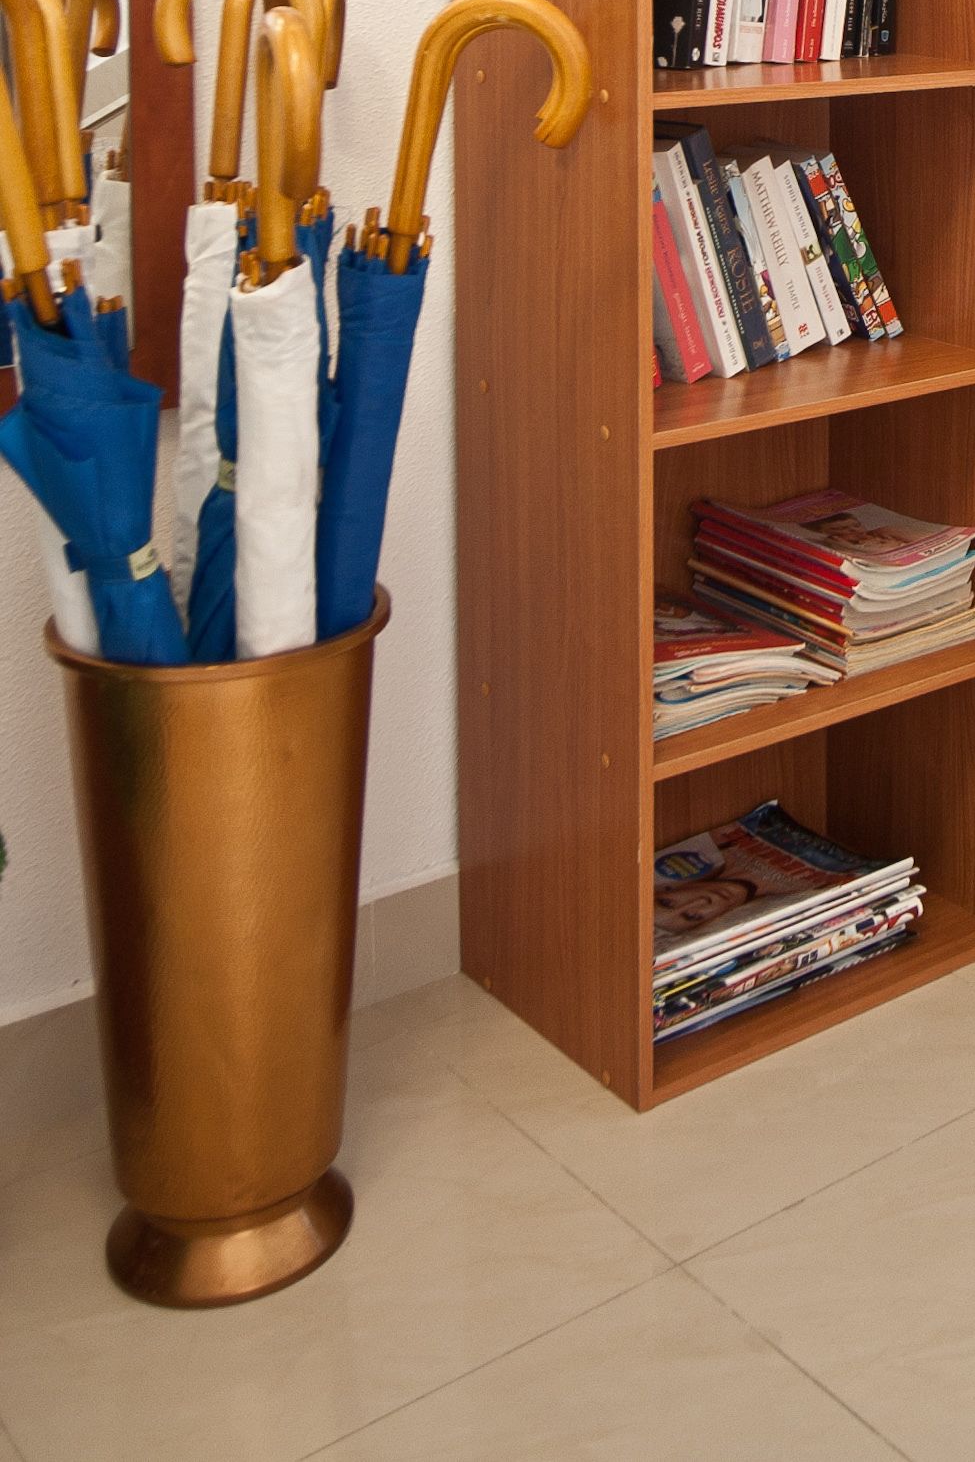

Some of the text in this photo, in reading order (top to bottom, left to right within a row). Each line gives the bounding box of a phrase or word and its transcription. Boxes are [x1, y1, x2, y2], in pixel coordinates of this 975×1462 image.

[693, 230, 714, 266] ГОРОДА
[752, 170, 802, 311] MATTHEW REILLY TEMPLE
